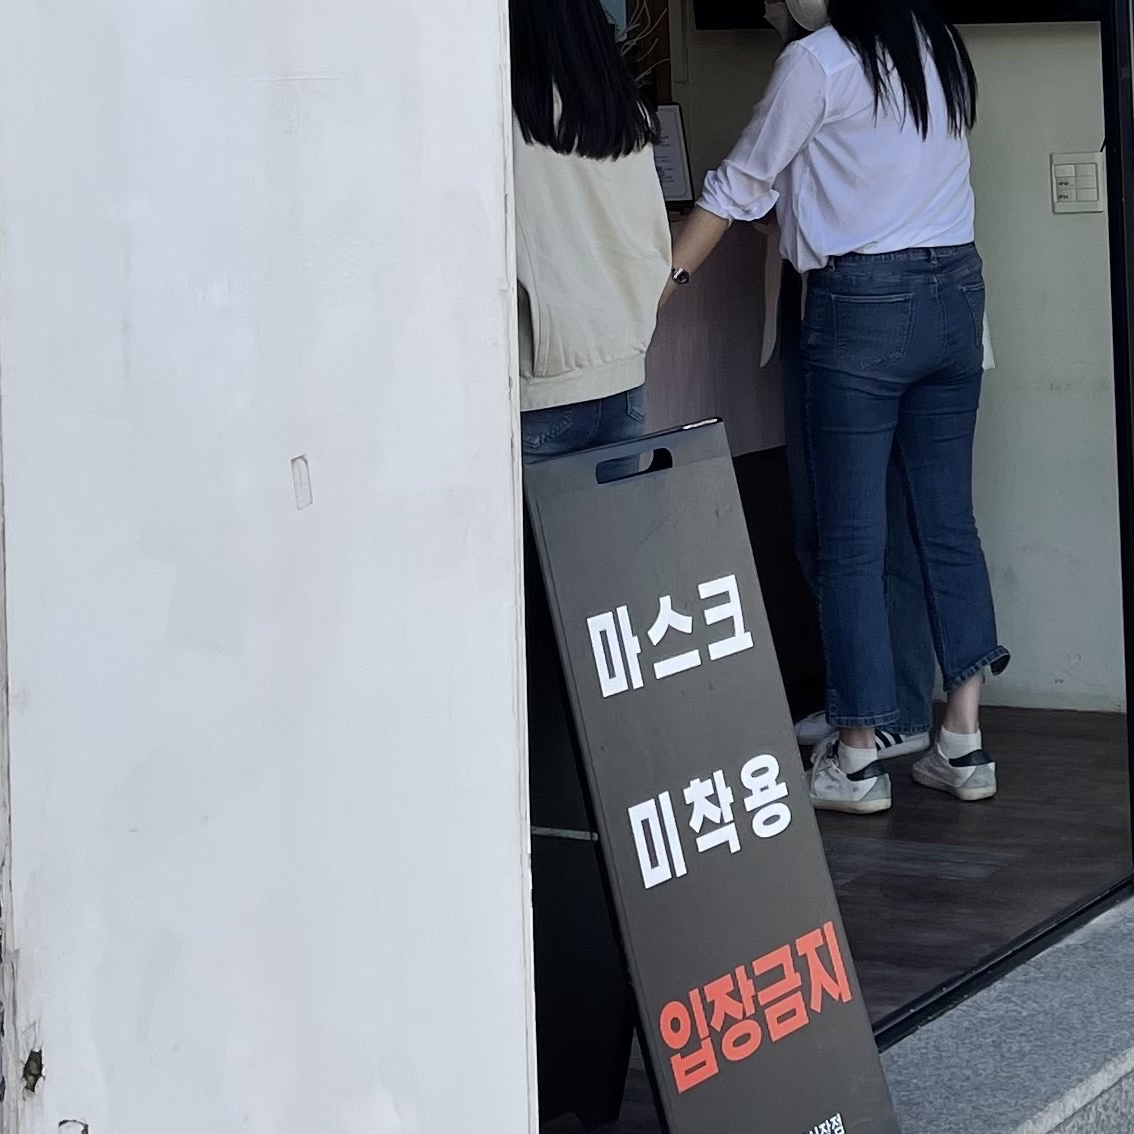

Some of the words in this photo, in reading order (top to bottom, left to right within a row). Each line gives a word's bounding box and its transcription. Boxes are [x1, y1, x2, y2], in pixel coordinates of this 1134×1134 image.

[586, 574, 754, 699] 마스크
[627, 753, 792, 890] 미착용
[659, 921, 853, 1094] 입장금지
